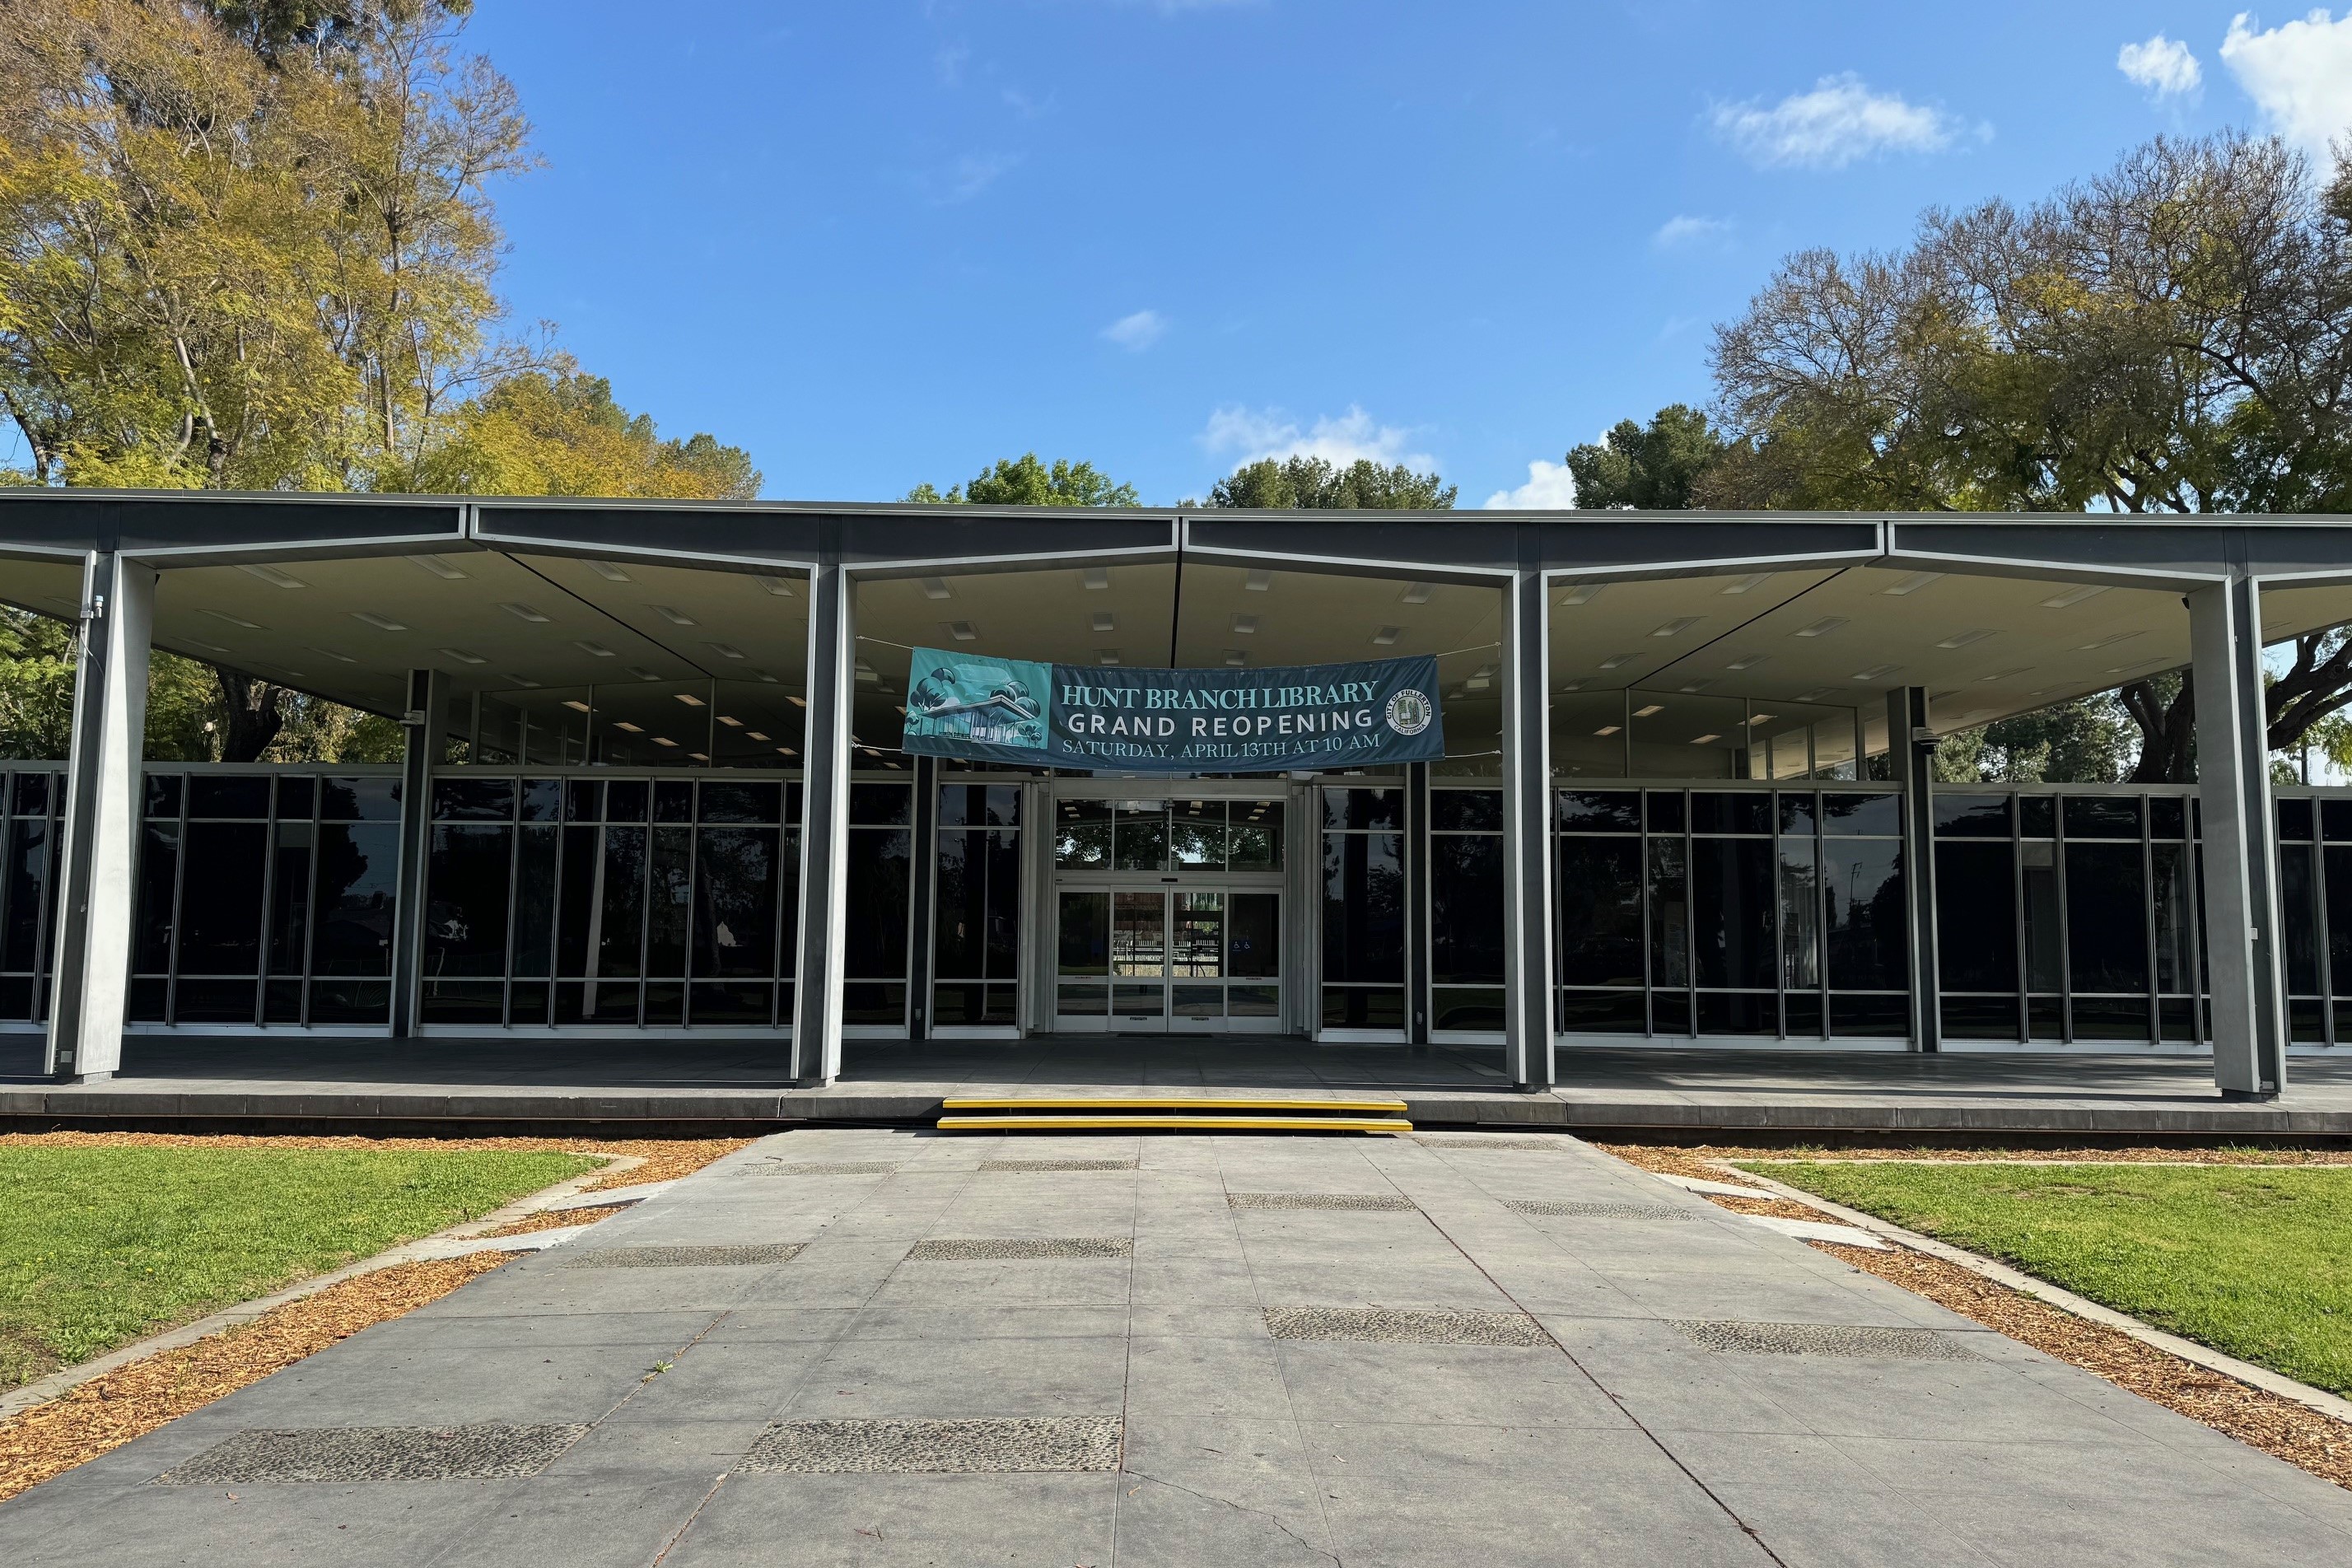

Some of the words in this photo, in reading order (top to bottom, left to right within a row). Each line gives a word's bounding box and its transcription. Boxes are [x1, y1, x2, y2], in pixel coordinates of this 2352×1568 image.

[1062, 684, 1140, 708] HUNT
[1145, 688, 1258, 710] BRANCH
[1262, 680, 1379, 708] LIBRARY
[1392, 693, 1400, 702] OF
[1401, 690, 1431, 716] FULLERTON
[1068, 713, 1175, 736] GRAND
[1192, 709, 1372, 737] REOPENING
[1393, 724, 1426, 735] CALIFORNIA
[1062, 740, 1175, 760] SATURDAY,
[1181, 744, 1238, 758] APRIL
[1240, 742, 1286, 758] 13TH
[1292, 740, 1319, 754] AT
[1323, 736, 1342, 752] 10
[1349, 733, 1380, 749] AM
